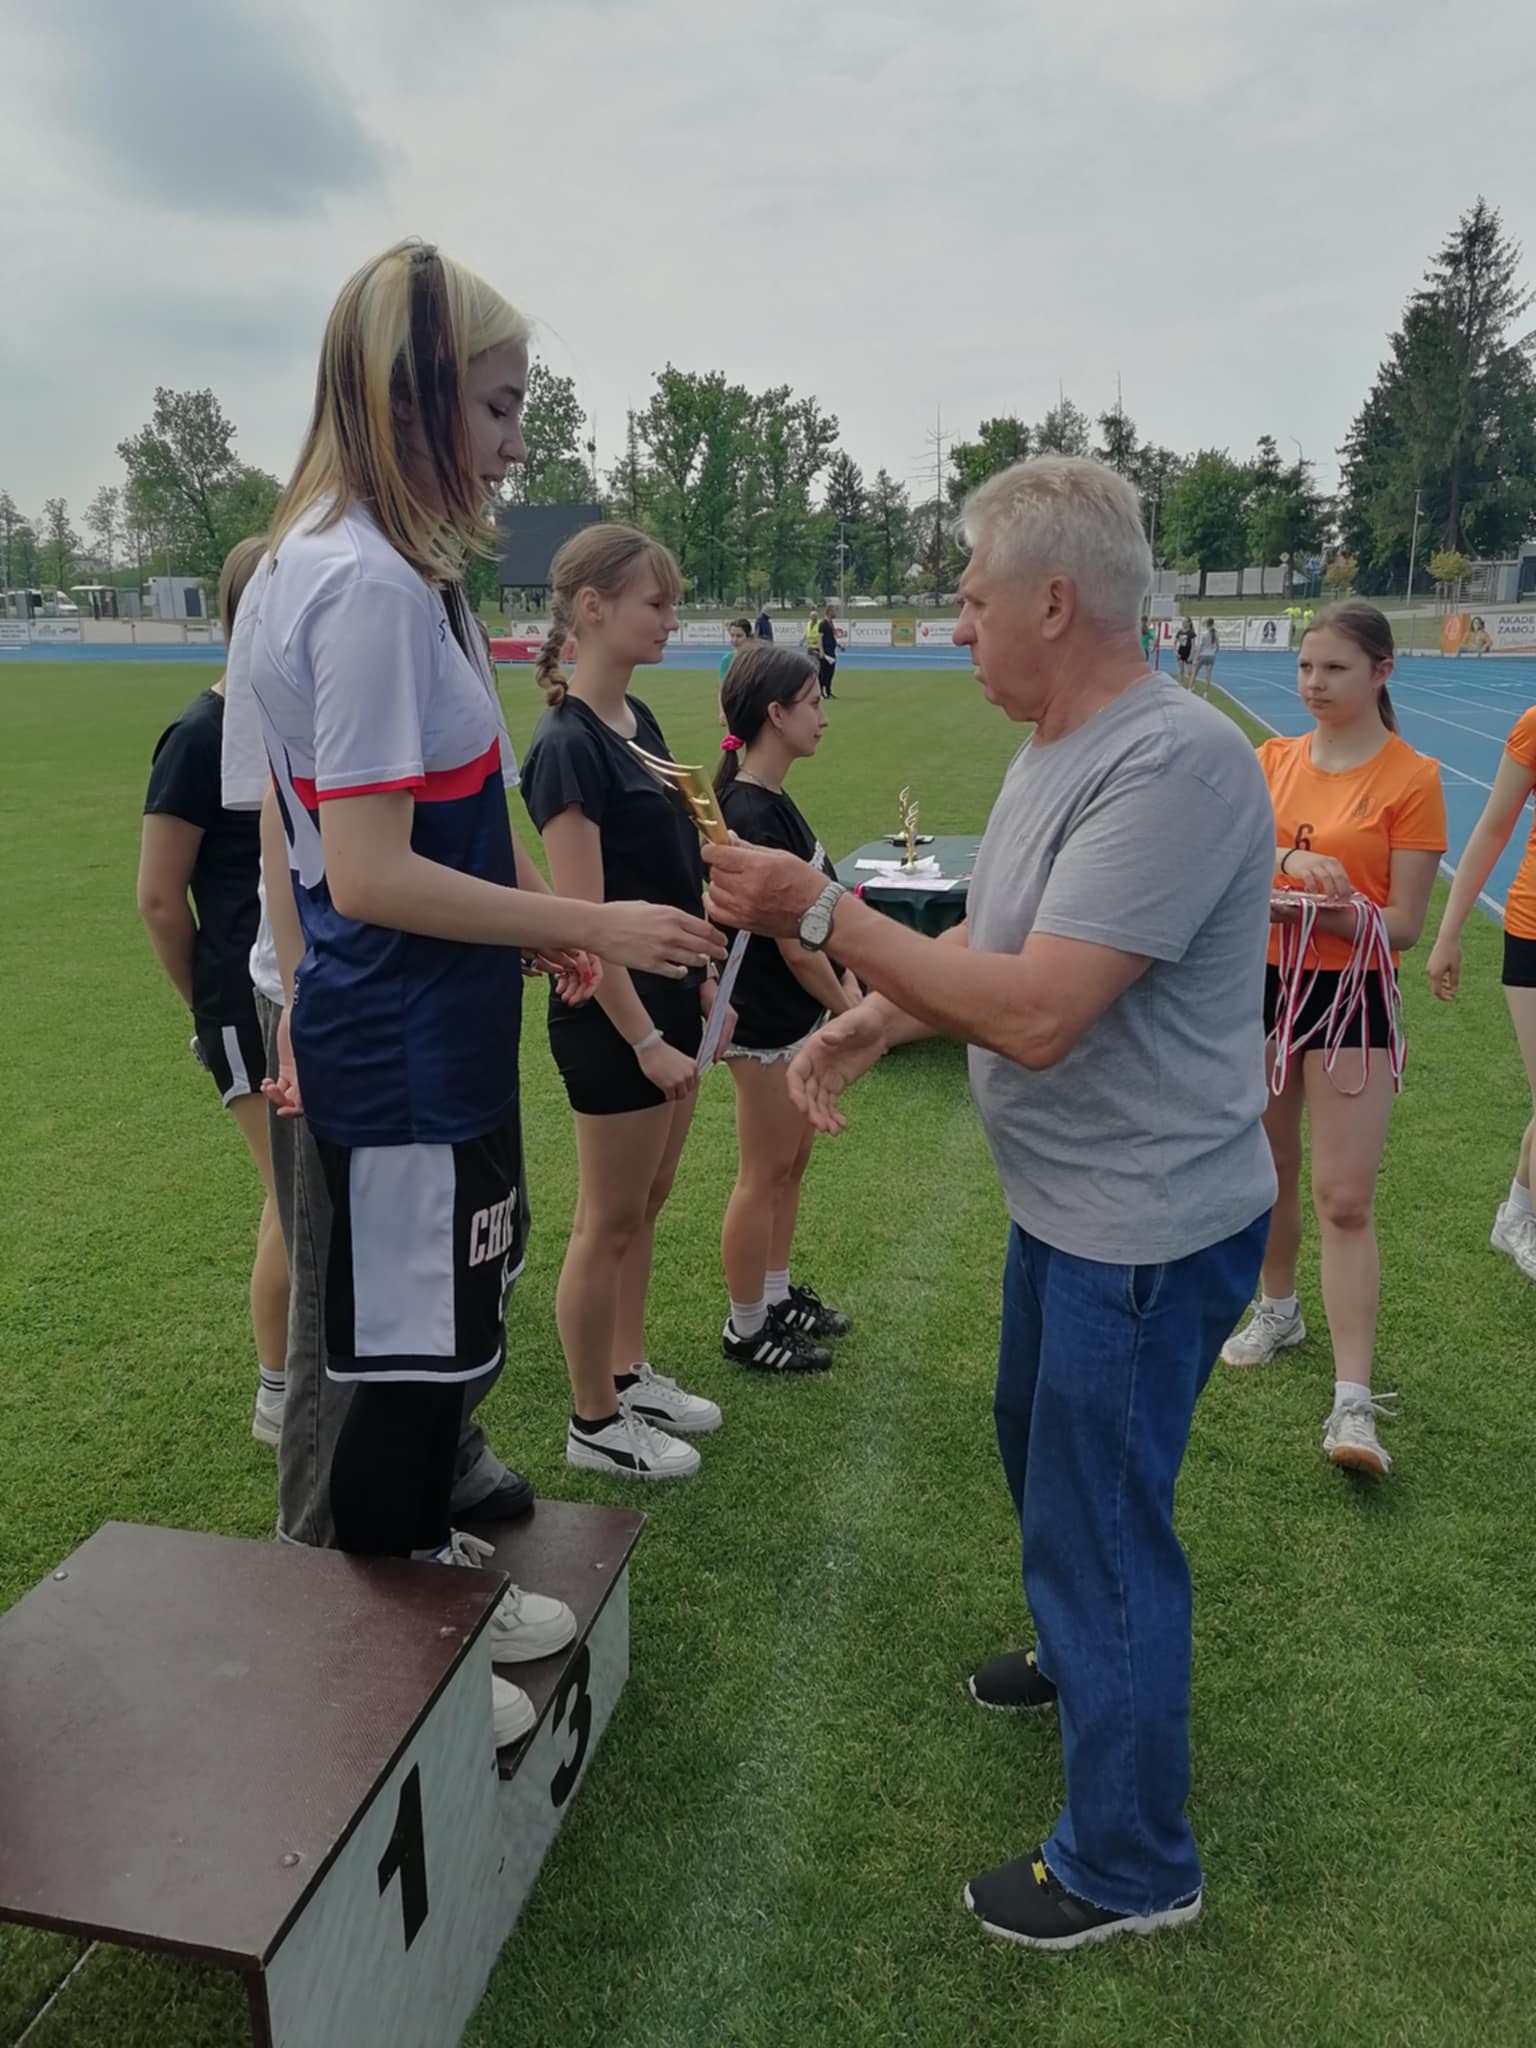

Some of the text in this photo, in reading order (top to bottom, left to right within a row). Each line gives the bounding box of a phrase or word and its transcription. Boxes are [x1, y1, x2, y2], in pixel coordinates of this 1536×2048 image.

[1295, 823, 1314, 851] 6
[550, 1644, 592, 1808] 3
[378, 1762, 430, 1953] 1
